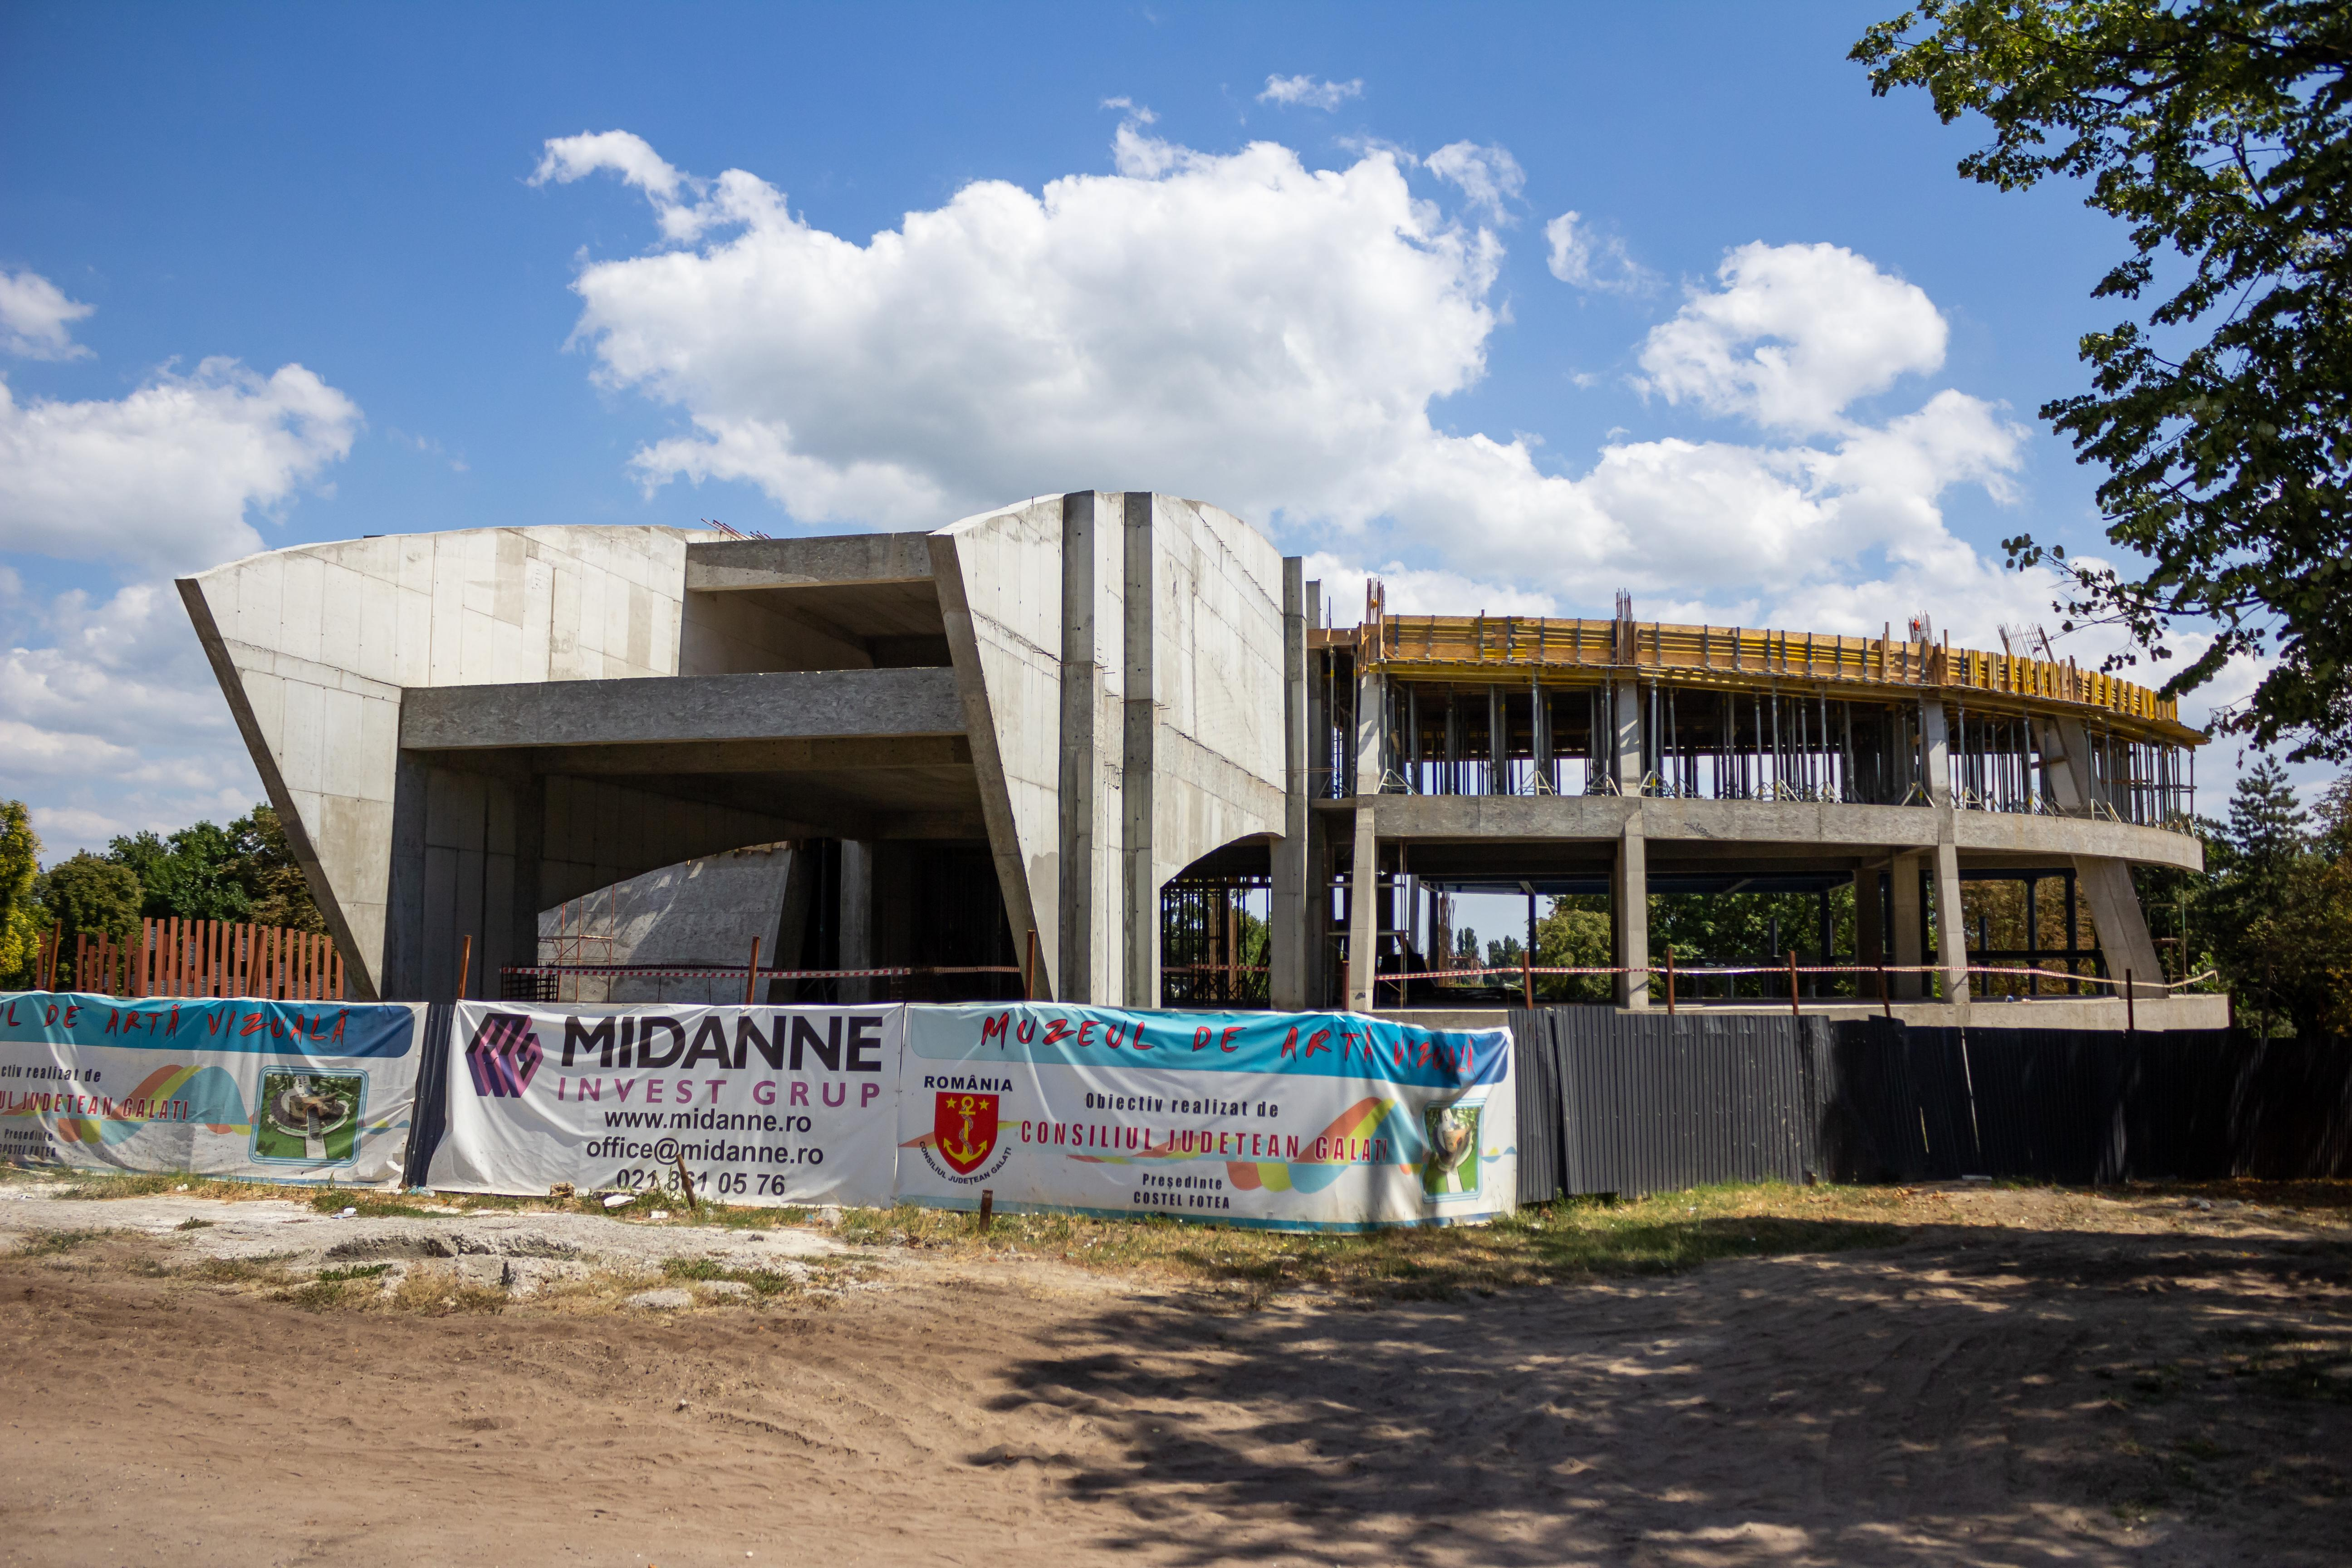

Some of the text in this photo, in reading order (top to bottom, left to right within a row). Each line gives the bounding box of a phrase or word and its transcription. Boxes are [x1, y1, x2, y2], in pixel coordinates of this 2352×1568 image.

[44, 1004, 85, 1028] DE
[562, 1016, 882, 1072] MIDANNE
[980, 1012, 1155, 1050] MUZEUL
[1192, 1026, 1247, 1053] DE
[1, 1064, 102, 1083] ctiv realizat de
[924, 1074, 1013, 1092] ROMÂNIA
[558, 1077, 881, 1108] INVEST GRUP
[1086, 1093, 1279, 1118] Obiectiv realizat de
[605, 1107, 811, 1132] www.midanne.ro
[1021, 1120, 1152, 1151] CONSILIUL
[587, 1136, 823, 1165] office@midanne.ro
[920, 1141, 946, 1179] CONSILIUL
[617, 1169, 657, 1190] 021
[718, 1172, 747, 1195] 05
[756, 1173, 785, 1196] 76
[1134, 1191, 1229, 1209] COSTEL FOTEA
